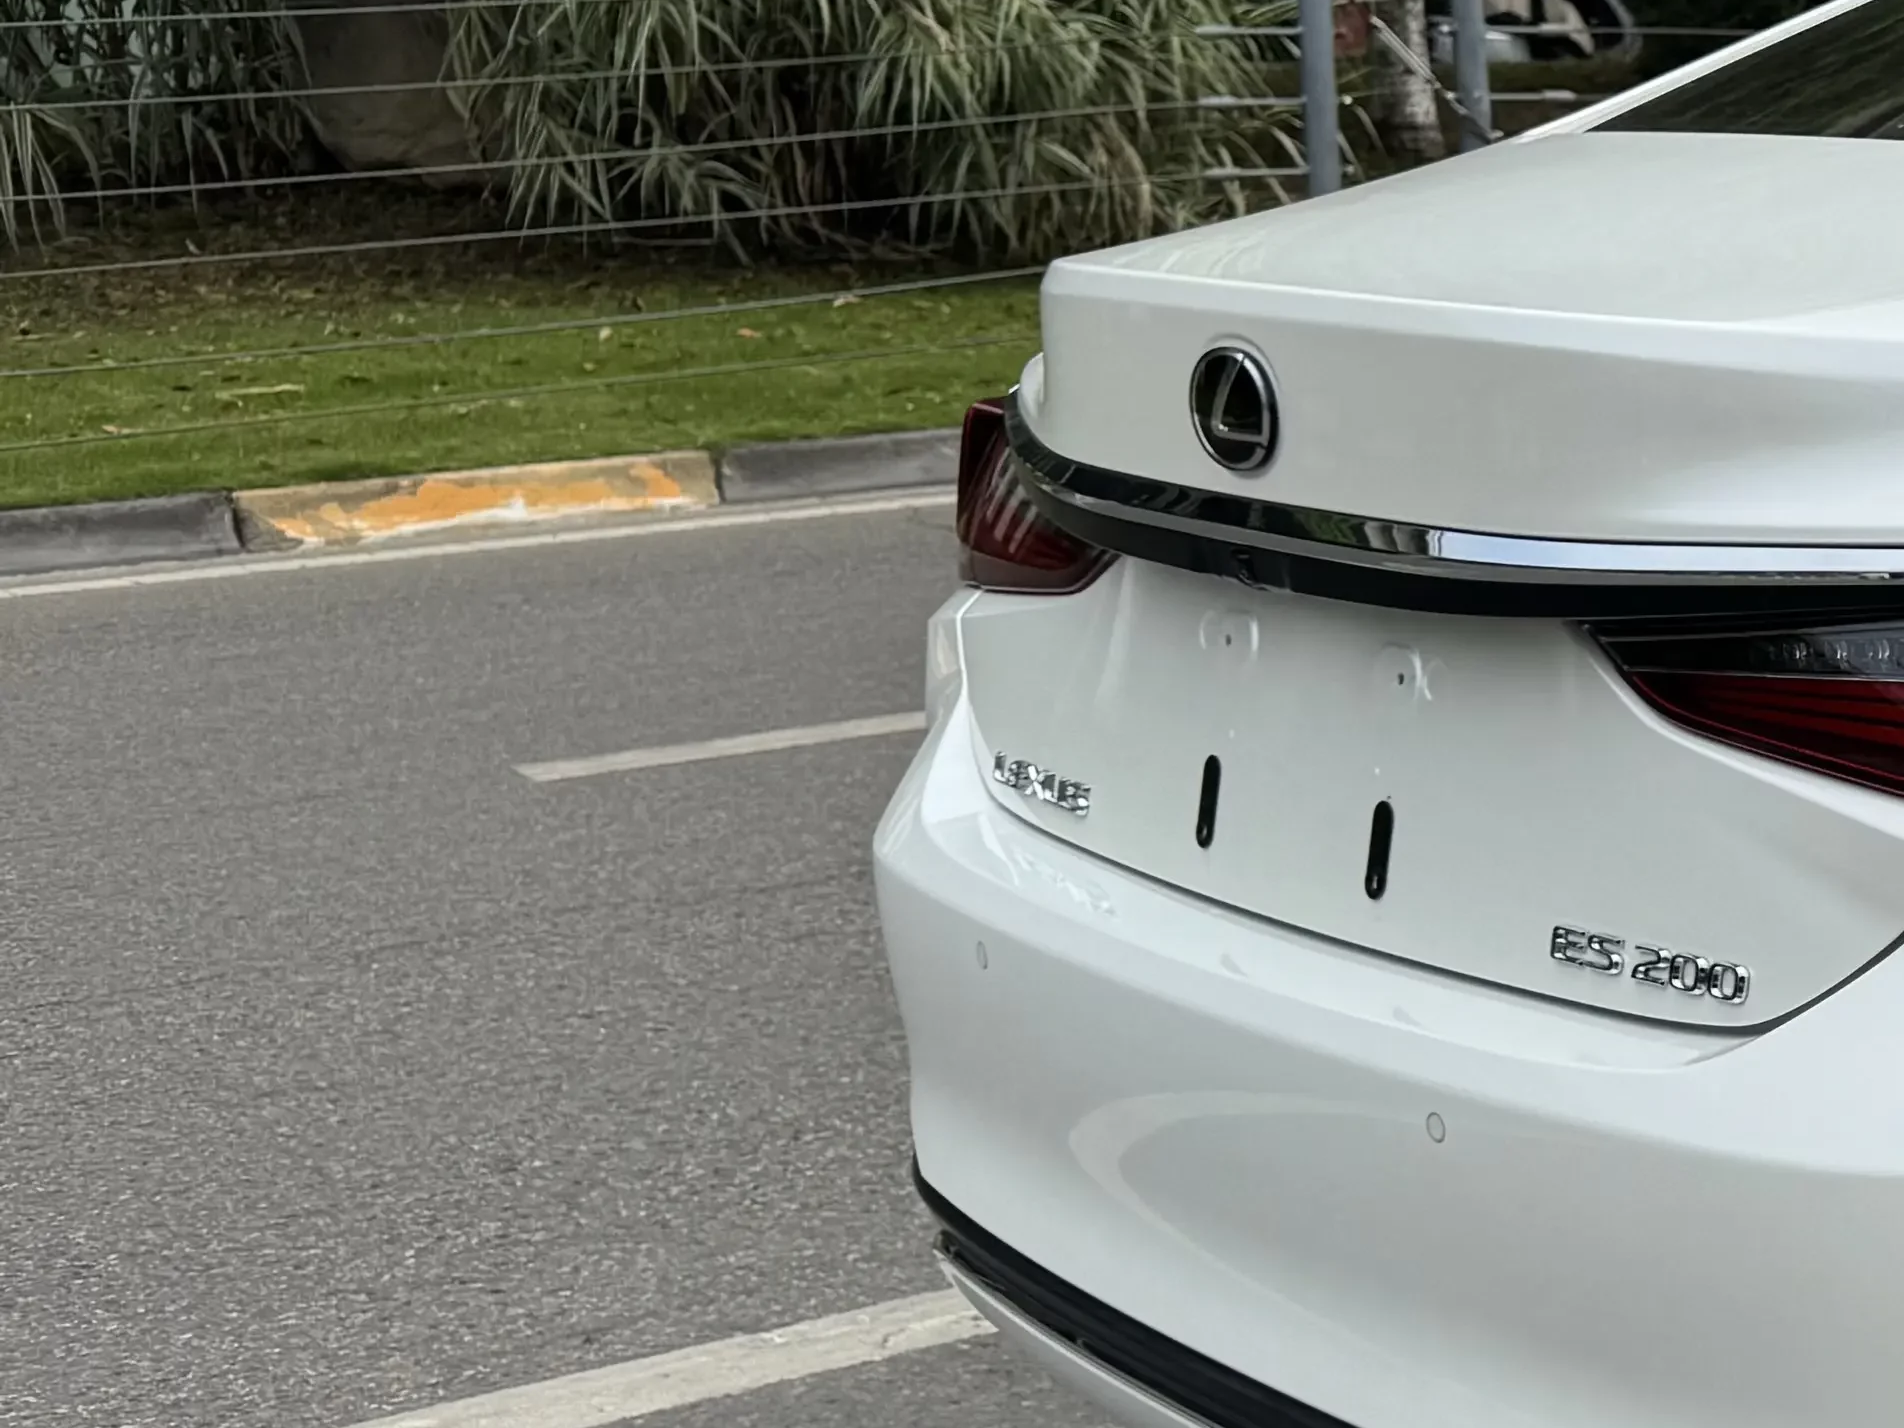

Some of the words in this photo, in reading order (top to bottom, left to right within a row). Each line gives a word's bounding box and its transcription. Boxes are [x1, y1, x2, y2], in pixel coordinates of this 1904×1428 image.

[993, 750, 1092, 817] LEXUS
[1550, 925, 1625, 975] ES
[1631, 944, 1751, 1005] 200
